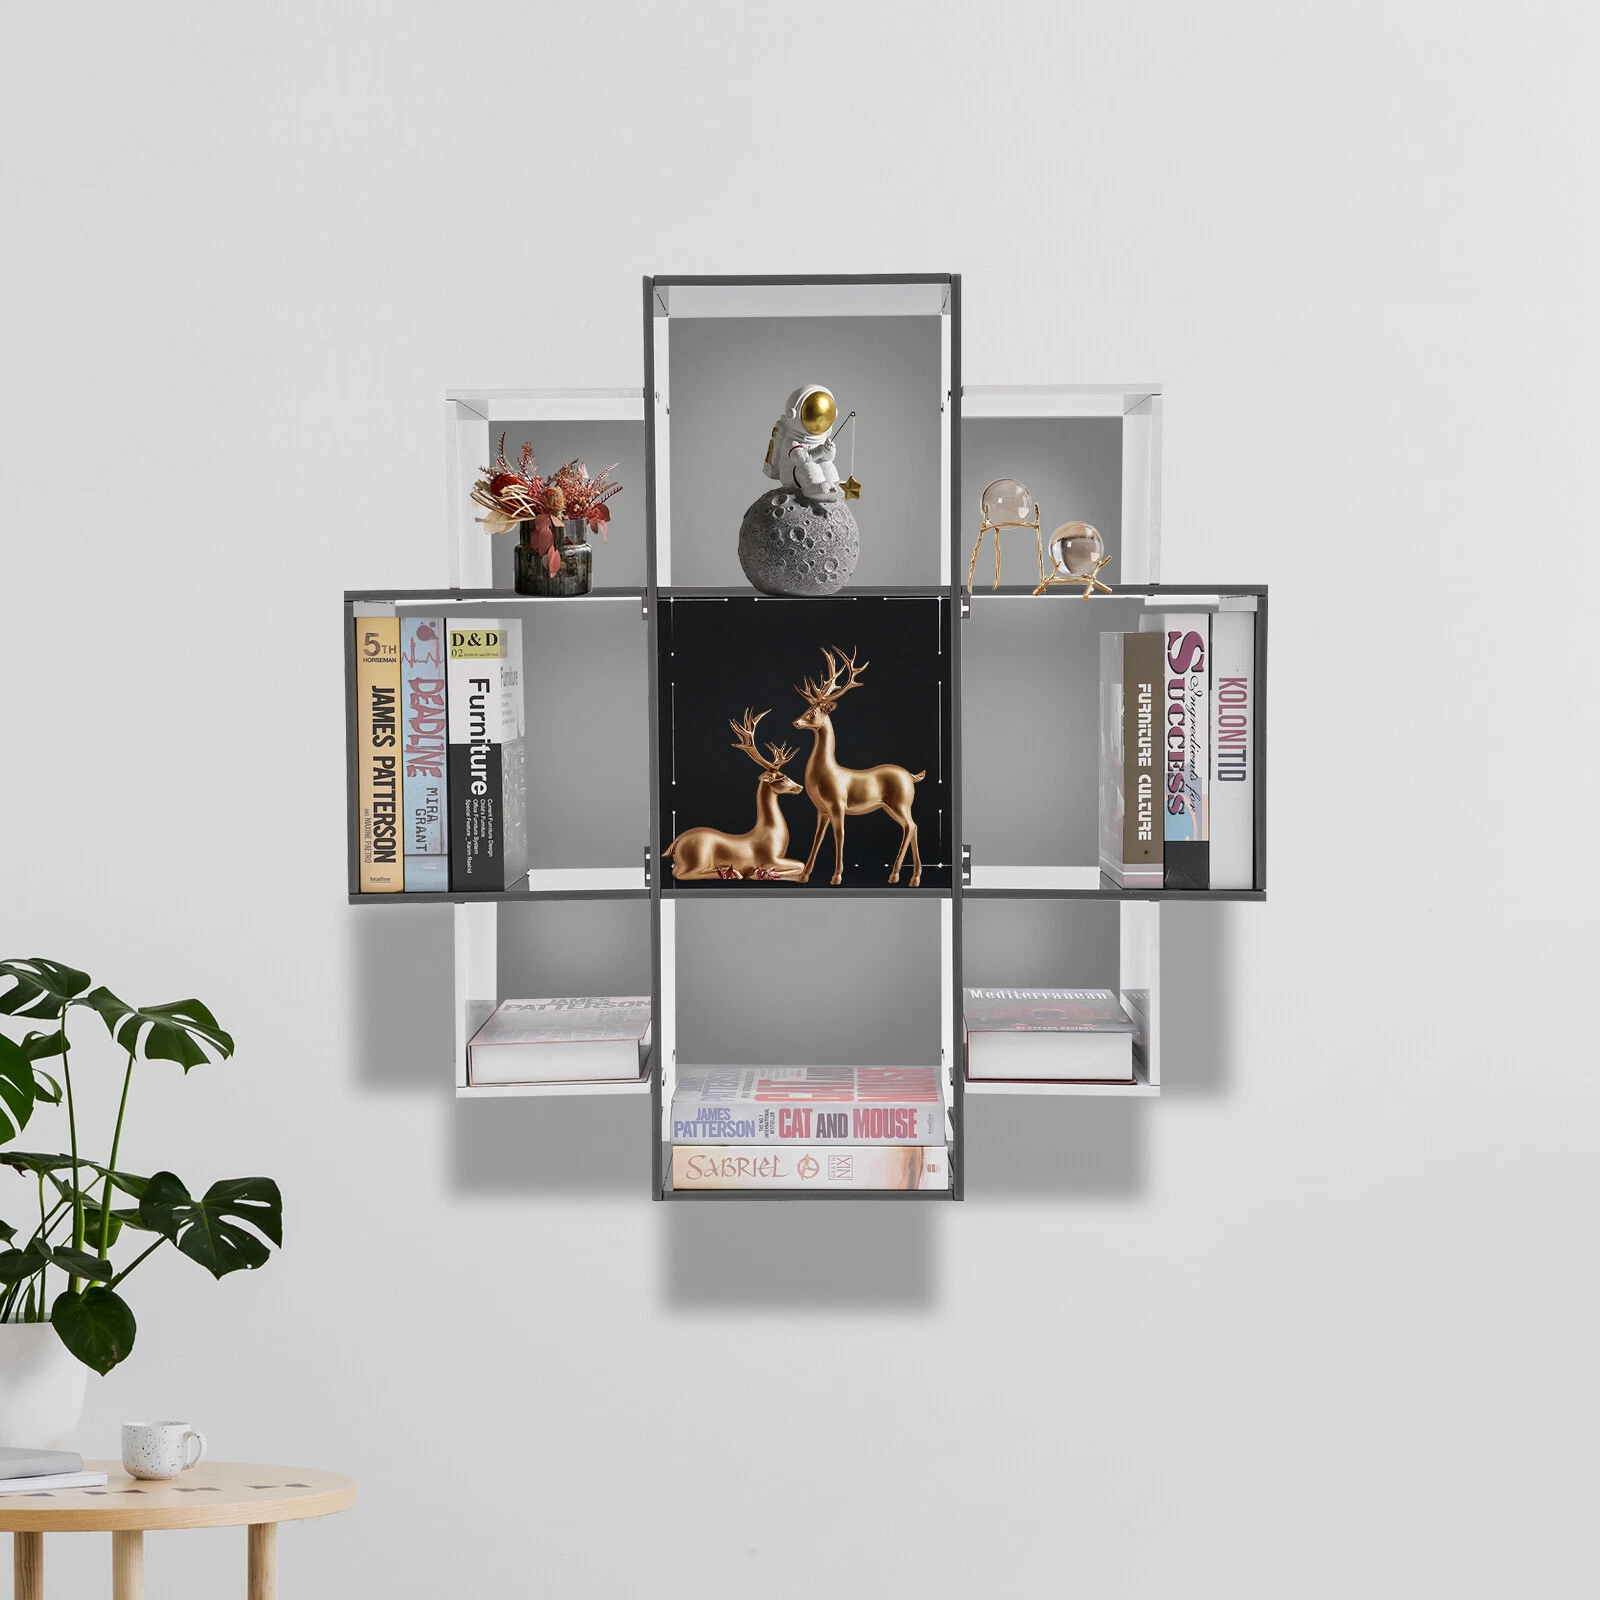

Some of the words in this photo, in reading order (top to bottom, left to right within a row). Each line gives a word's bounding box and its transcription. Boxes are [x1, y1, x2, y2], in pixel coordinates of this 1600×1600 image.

[363, 632, 397, 657] 5TH
[451, 648, 464, 658] 02
[371, 686, 396, 748] JAMES
[404, 677, 446, 778] DEADLINE
[1185, 675, 1203, 782] Ingredients
[1217, 677, 1248, 782] KOLONITID
[469, 678, 491, 795] Furniture
[372, 756, 397, 863] PATTERSON
[426, 787, 439, 823] MIRA
[1138, 774, 1152, 841] CULTURE
[1185, 783, 1201, 813] for
[364, 817, 372, 840] MAXINE
[415, 808, 428, 852] GRANT
[364, 841, 372, 863] PAETRO
[502, 1000, 651, 1011] PATTERSON
[547, 997, 611, 1006] JAMES
[969, 989, 1108, 1000] Mediterranean
[696, 1107, 731, 1121] JAMES
[778, 1107, 813, 1139] CAT
[815, 1112, 849, 1139] AND
[852, 1107, 918, 1139] MOUSE
[674, 1120, 756, 1138] PATTERSON
[685, 1153, 792, 1181] SABRIEL
[836, 1157, 852, 1179] NIX
